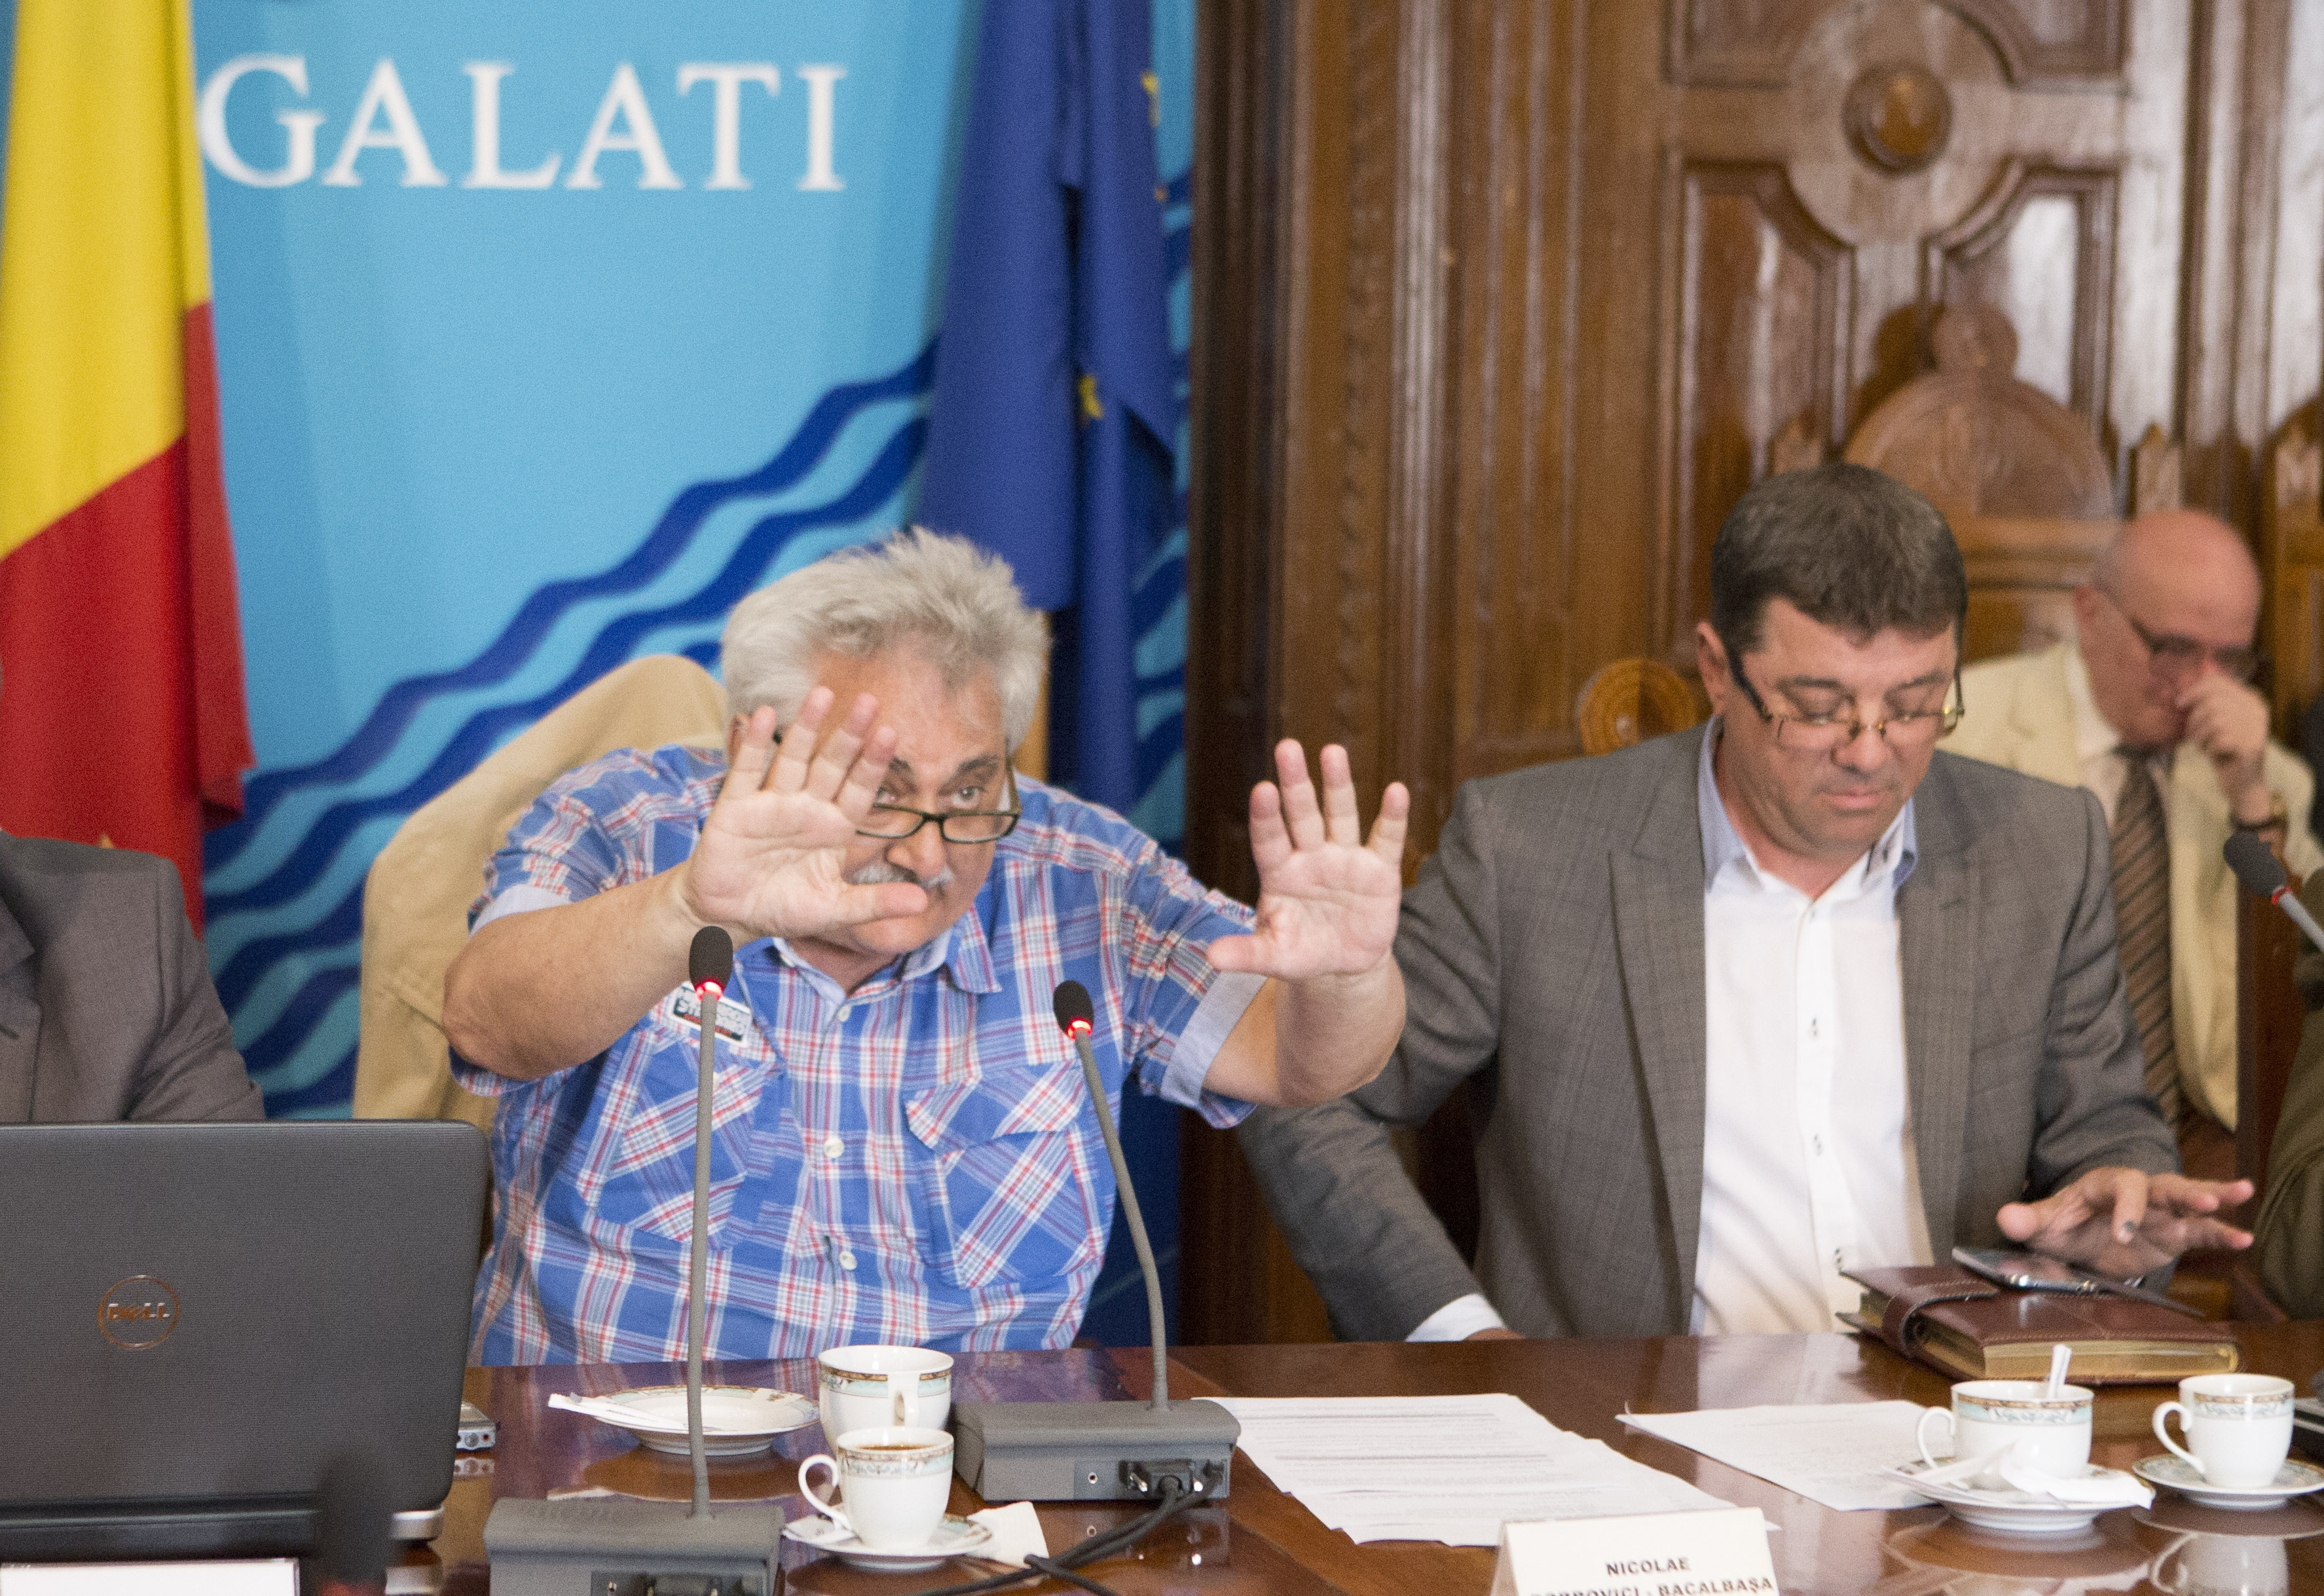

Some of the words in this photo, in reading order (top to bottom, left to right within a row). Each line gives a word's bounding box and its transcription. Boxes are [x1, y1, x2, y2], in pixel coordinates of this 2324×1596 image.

[198, 52, 847, 191] GALATI
[107, 1303, 170, 1320] DELL
[1606, 1557, 1691, 1576] NICOLAE
